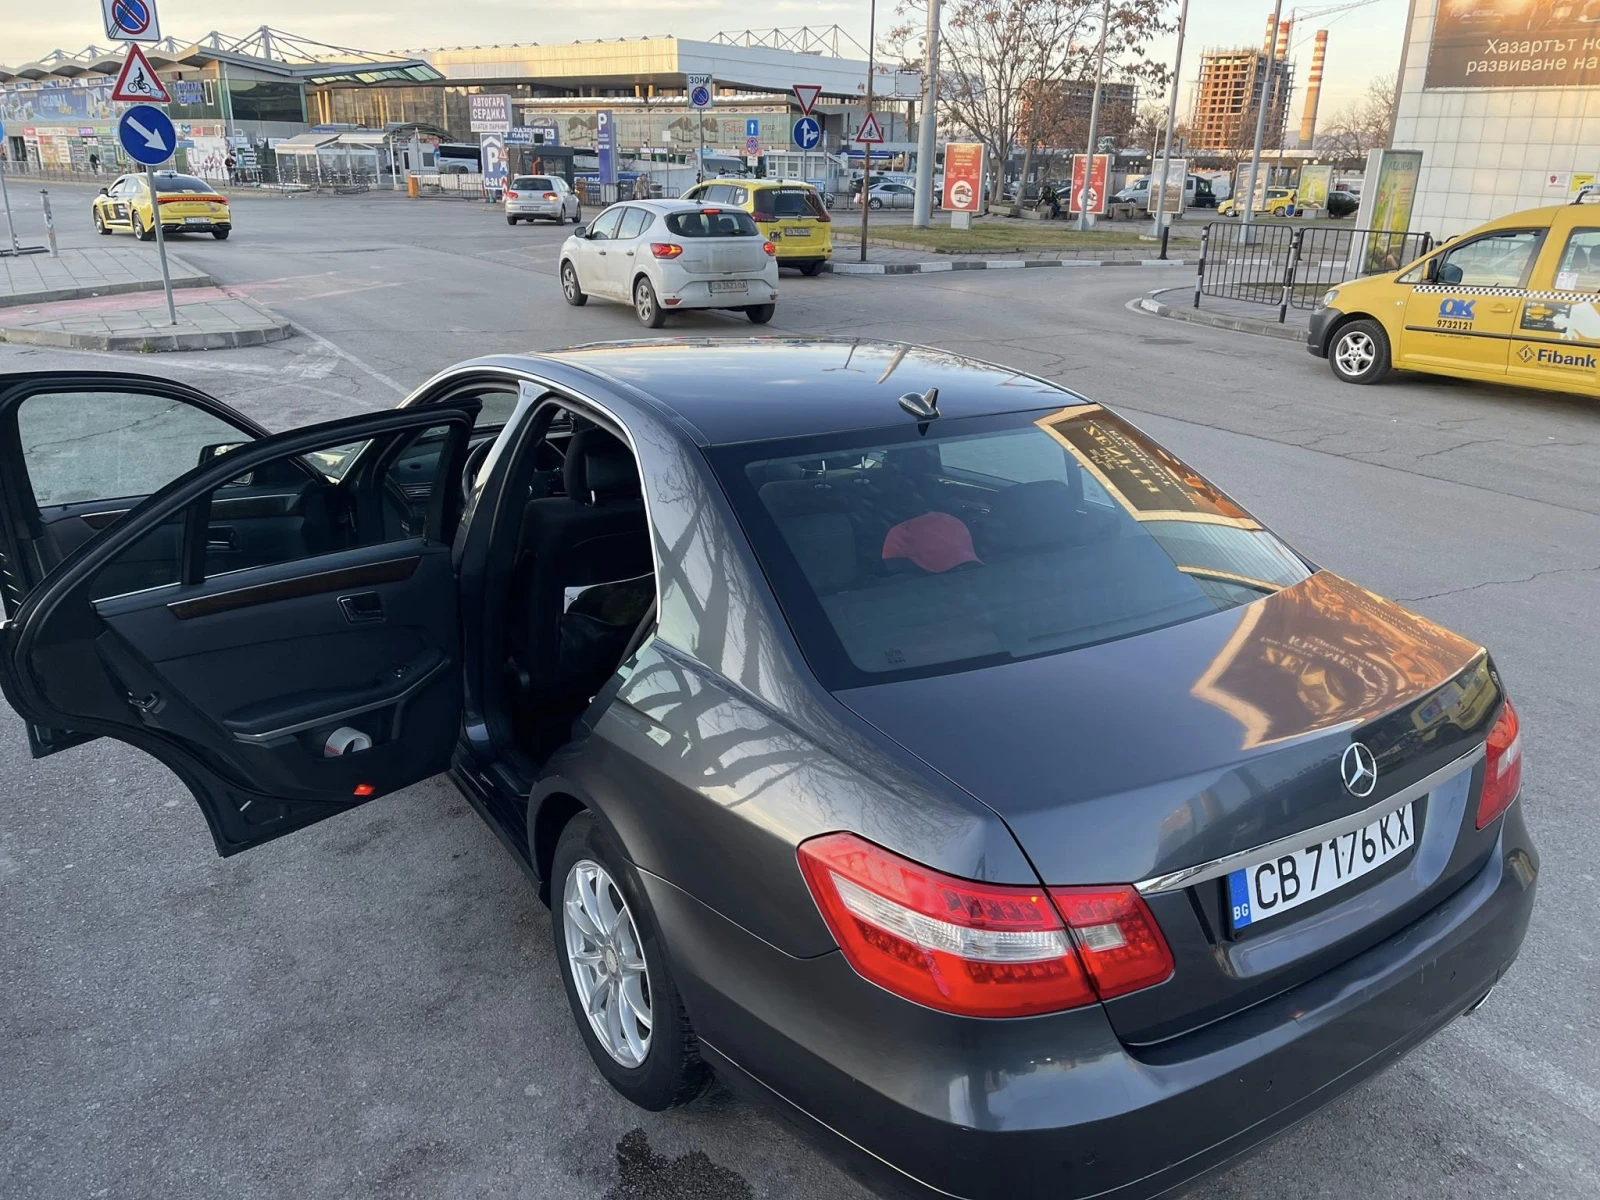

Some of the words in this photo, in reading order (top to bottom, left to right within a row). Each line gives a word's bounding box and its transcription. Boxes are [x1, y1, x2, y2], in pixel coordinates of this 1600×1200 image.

[1484, 38, 1577, 56] Хазартът
[1465, 58, 1567, 76] развиване
[1573, 56, 1598, 70] на
[689, 76, 710, 84] ЗОНА
[472, 97, 505, 107] АВТОГАРА
[472, 108, 506, 121] СЕРДИКА
[486, 146, 499, 172] P
[1440, 298, 1477, 317] OK
[1437, 319, 1473, 331] 9732121
[1537, 348, 1597, 369] Fibank
[1233, 902, 1250, 921] BG
